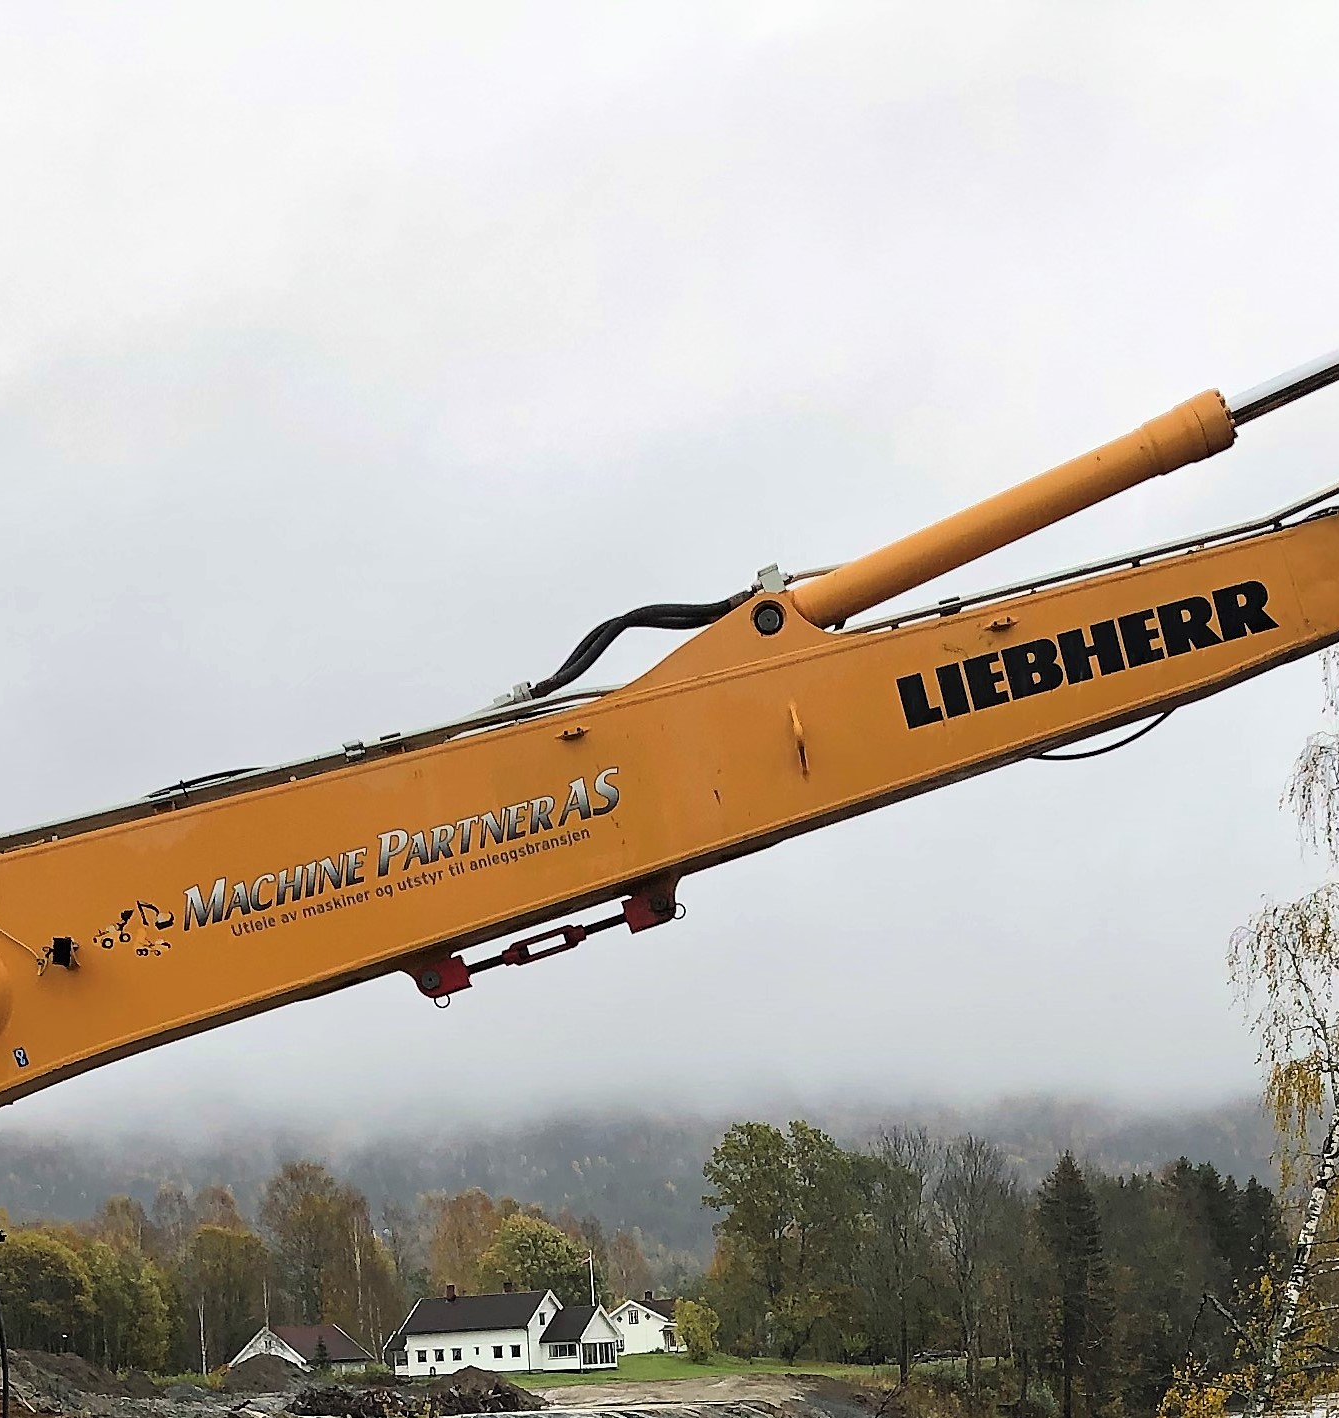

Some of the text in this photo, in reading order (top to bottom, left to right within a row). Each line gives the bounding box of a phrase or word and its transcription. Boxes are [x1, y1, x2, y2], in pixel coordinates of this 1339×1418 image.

[896, 580, 1280, 730] LIEBHERR
[557, 766, 621, 827] AS
[230, 827, 591, 937] Utleie av maskiner og utstyr til anleggsbransjen
